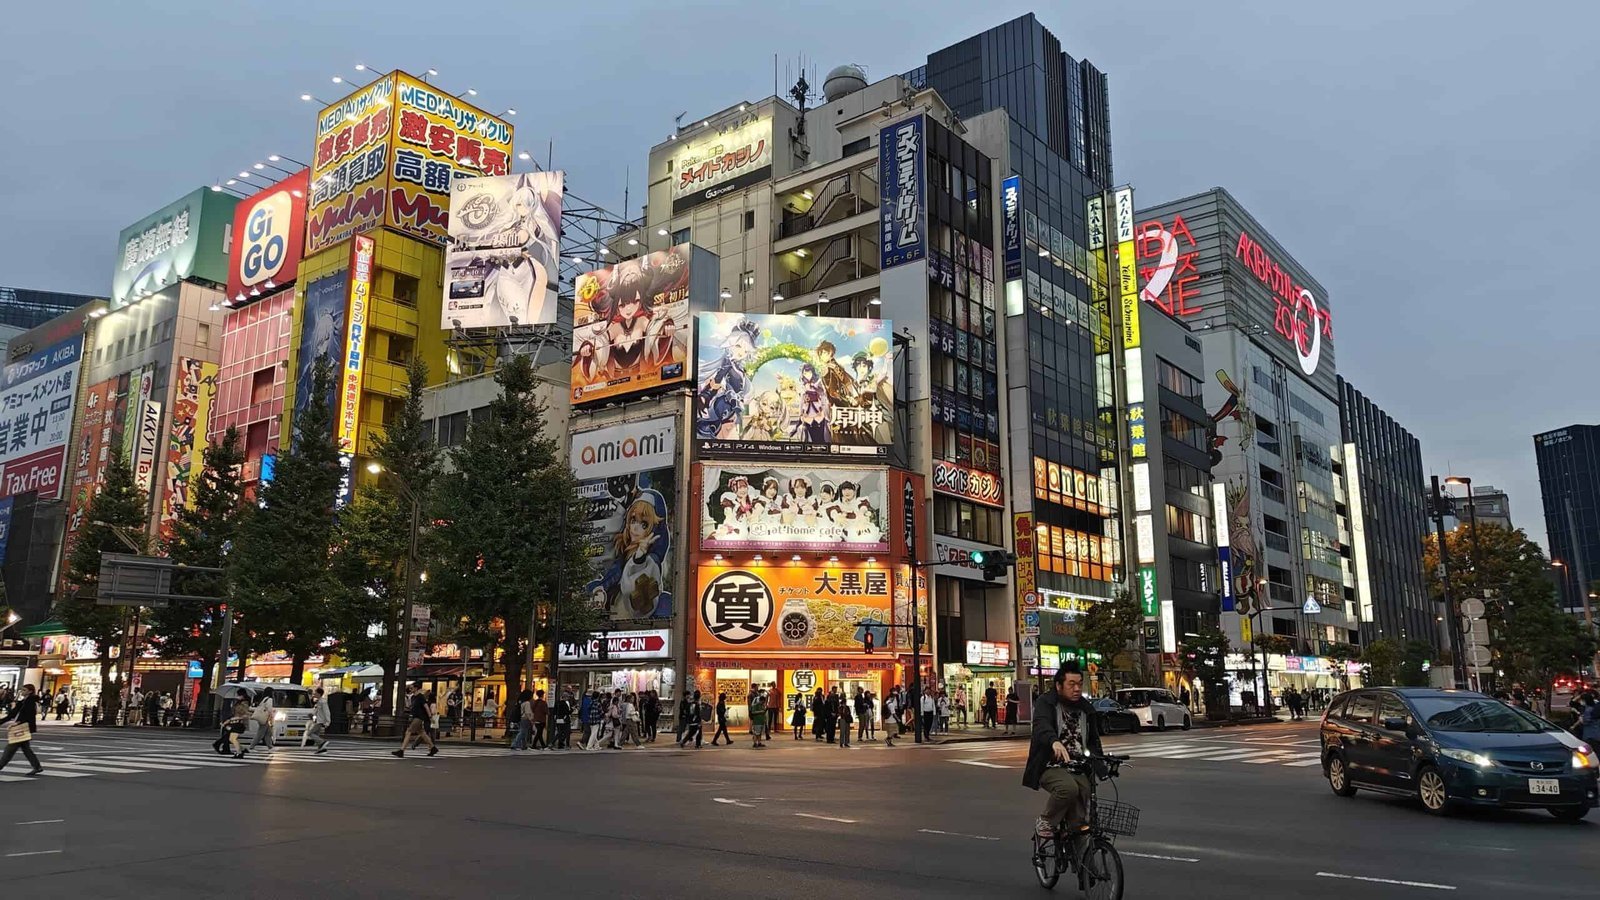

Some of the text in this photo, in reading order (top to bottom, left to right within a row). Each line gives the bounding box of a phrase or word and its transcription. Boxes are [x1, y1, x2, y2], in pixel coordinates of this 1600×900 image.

[401, 84, 511, 144] MEDIAリサイクル
[316, 106, 390, 171] 激安販売
[399, 110, 507, 176] 激安販売
[312, 142, 388, 209] 高額買取
[680, 139, 765, 190] メイドカジノ
[896, 122, 919, 248] アメニティドリーム
[248, 208, 273, 243] Gi
[402, 222, 438, 239] ムーラン
[1119, 194, 1130, 238] スーパービル
[244, 234, 284, 279] GO
[941, 272, 953, 287] 7F
[1121, 264, 1131, 292] Yellow
[1123, 298, 1134, 344] Submarine
[1272, 295, 1311, 358] ZONE
[52, 344, 75, 363] AKIBA
[942, 336, 954, 353] 6F
[2, 370, 73, 413] アミューズメント館
[87, 391, 99, 409] 4F
[0, 406, 48, 455] 営業中
[142, 403, 158, 447] AKKY
[830, 399, 883, 434] 原神
[943, 406, 956, 423] 5F
[1130, 407, 1146, 457] 秋葉館
[78, 450, 90, 468] 3F
[581, 432, 665, 466] amiami
[6, 470, 30, 496] Tax
[29, 465, 57, 489] Free
[934, 463, 1001, 502] メイドカジノ
[779, 586, 810, 595] チケット
[814, 571, 888, 596] 大黒屋
[1025, 562, 1033, 586] TAX
[711, 582, 765, 635] 質
[1026, 594, 1035, 603] 40
[591, 638, 628, 652] CMIC
[629, 637, 646, 651] ZIN
